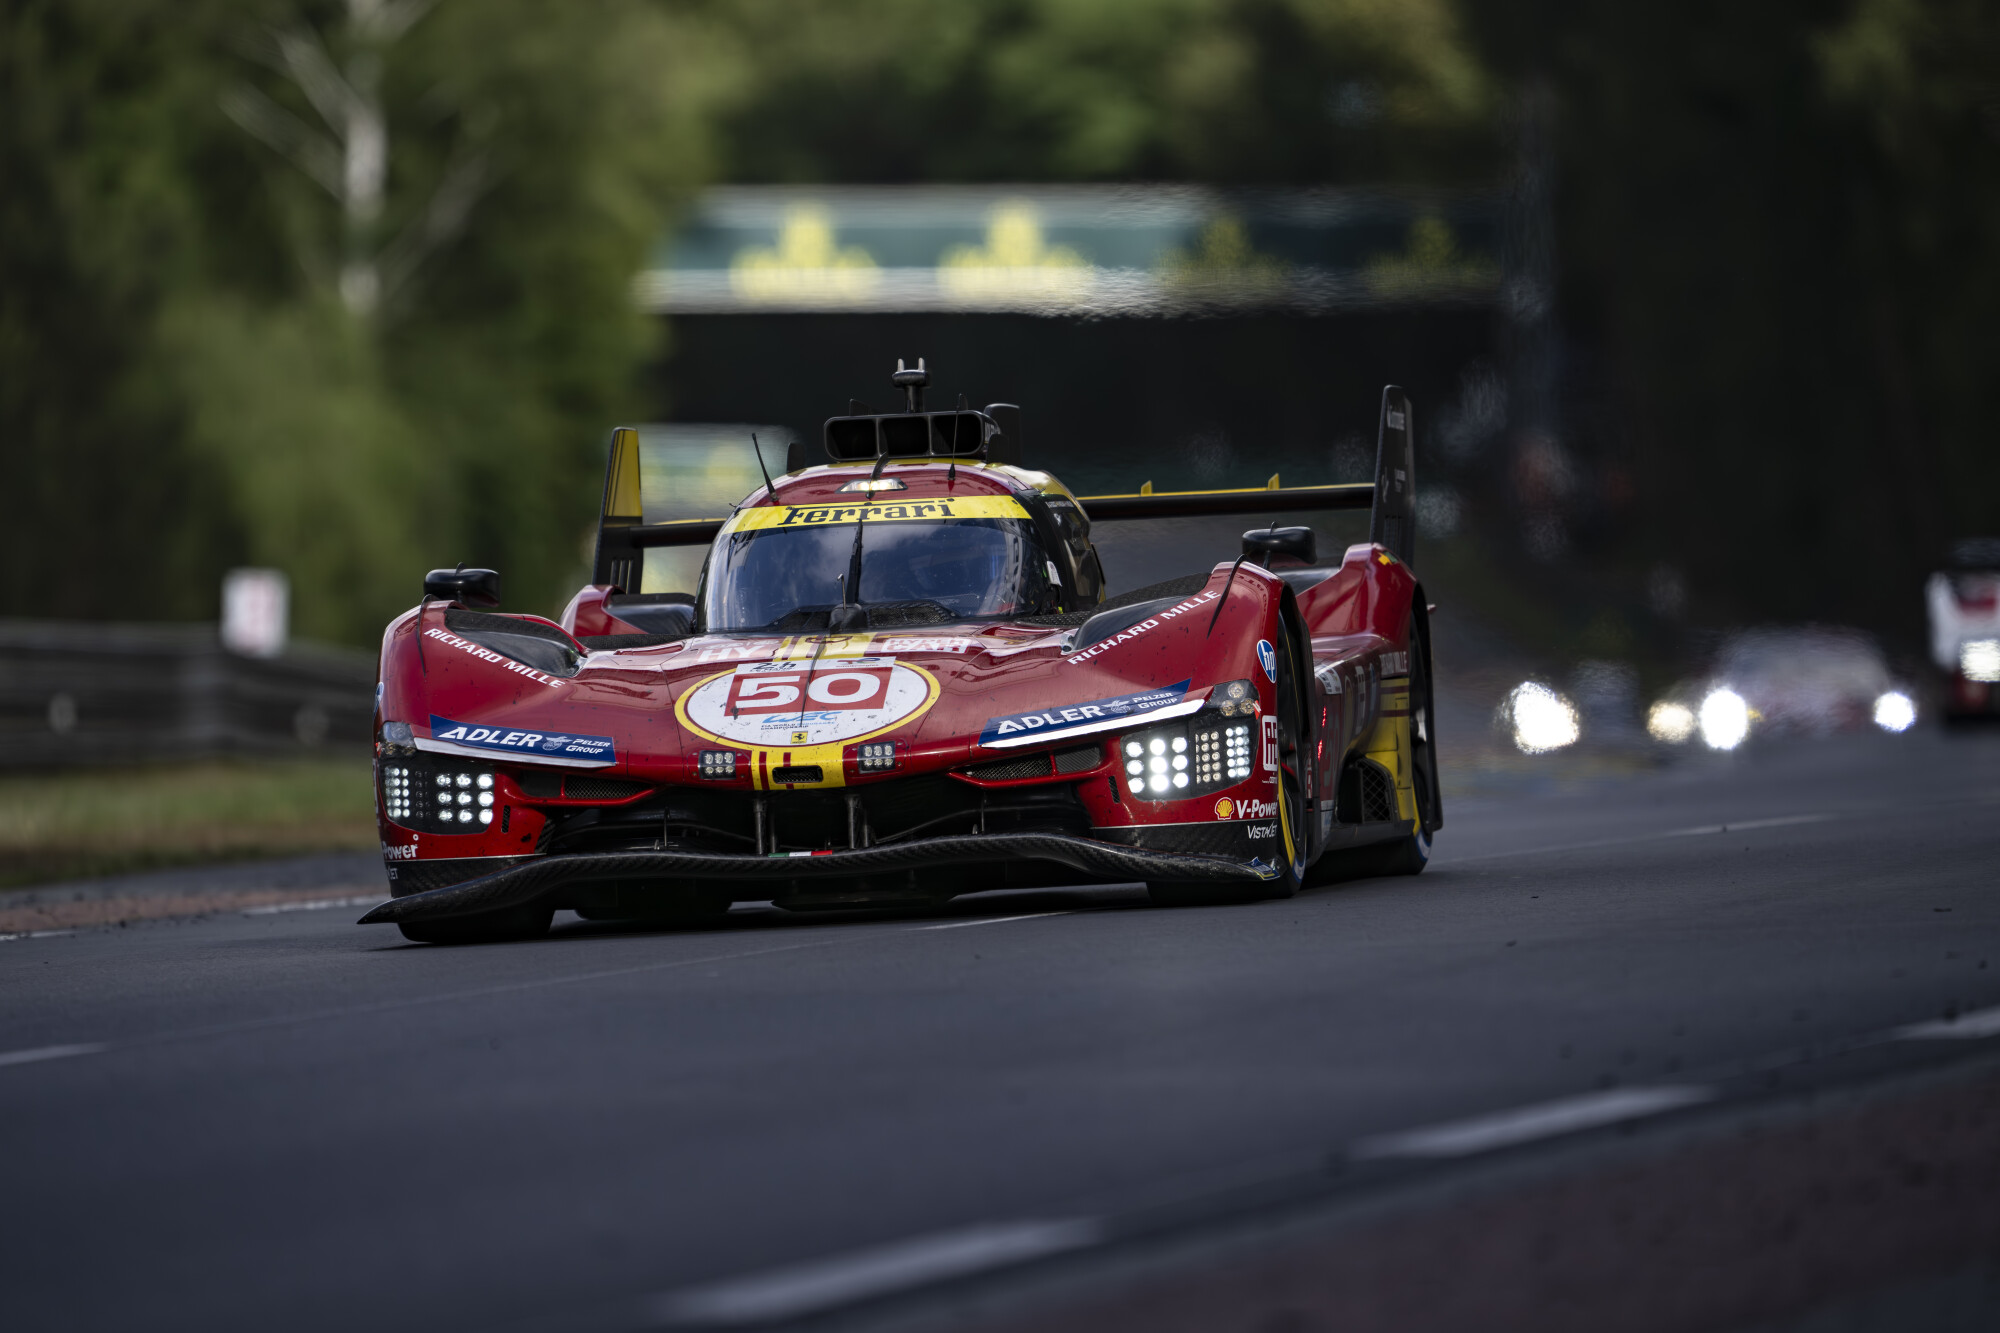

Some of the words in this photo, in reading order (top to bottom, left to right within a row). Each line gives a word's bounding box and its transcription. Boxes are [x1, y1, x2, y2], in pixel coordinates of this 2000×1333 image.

[778, 498, 955, 525] Ferrari
[1067, 618, 1160, 666] RICHARD
[1160, 590, 1221, 622] MILLE
[423, 628, 503, 663] RICHARD
[503, 661, 566, 688] MILLE
[1260, 641, 1275, 682] hp
[735, 672, 881, 708] 50
[1132, 692, 1174, 704] PELZER
[1138, 697, 1179, 710] GROUP
[762, 711, 843, 723] WEC
[997, 705, 1106, 736] ADLER
[438, 726, 544, 749] ADLER
[565, 744, 603, 755] GROUP
[572, 737, 611, 748] PELZER
